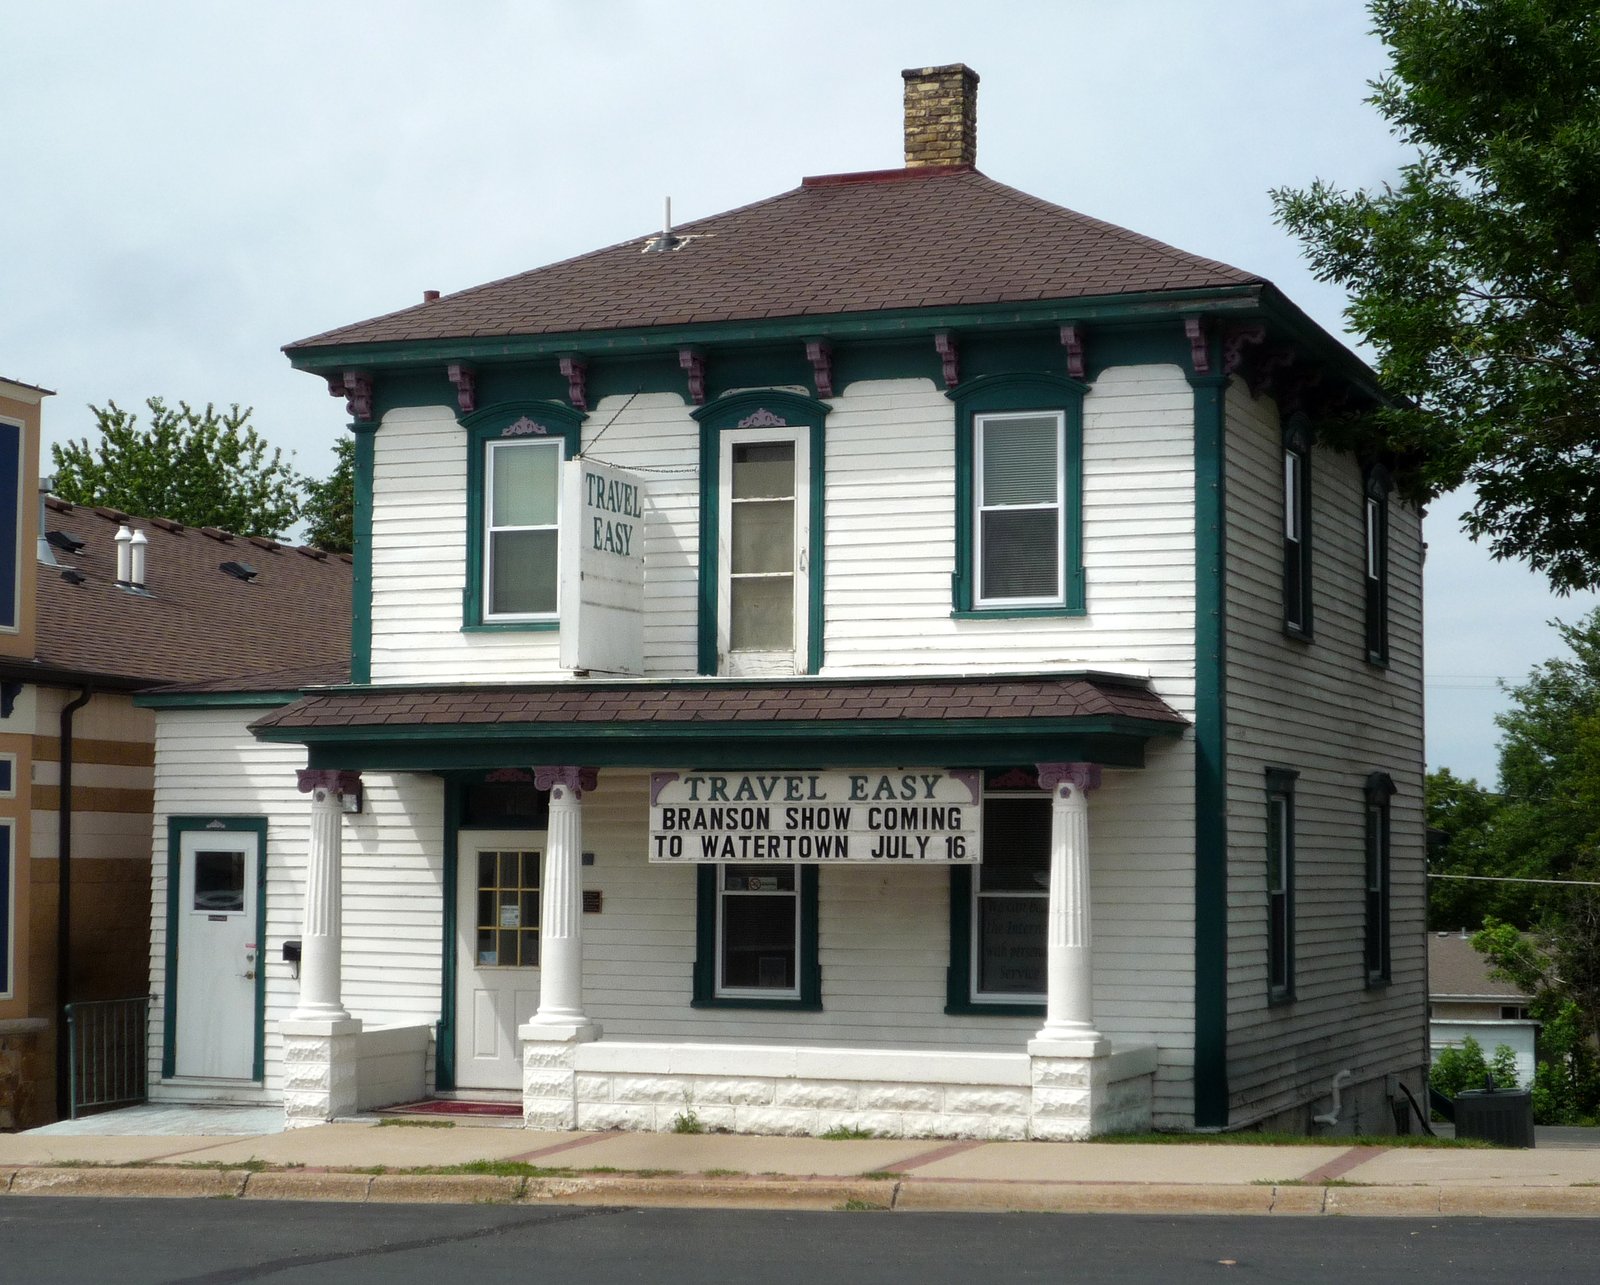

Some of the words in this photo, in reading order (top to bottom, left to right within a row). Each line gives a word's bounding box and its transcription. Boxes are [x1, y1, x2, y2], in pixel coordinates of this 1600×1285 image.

[585, 473, 642, 518] TRAVEL
[593, 516, 633, 556] EASY
[685, 776, 827, 801] TRAVEL
[849, 775, 943, 800] EASY
[663, 808, 770, 830] BRANSON
[786, 808, 851, 830] SHOW
[868, 808, 961, 830] COMING
[655, 835, 682, 857] TO
[702, 835, 848, 858] WATERTOWN
[872, 835, 930, 858] JULY
[945, 835, 966, 858] 16
